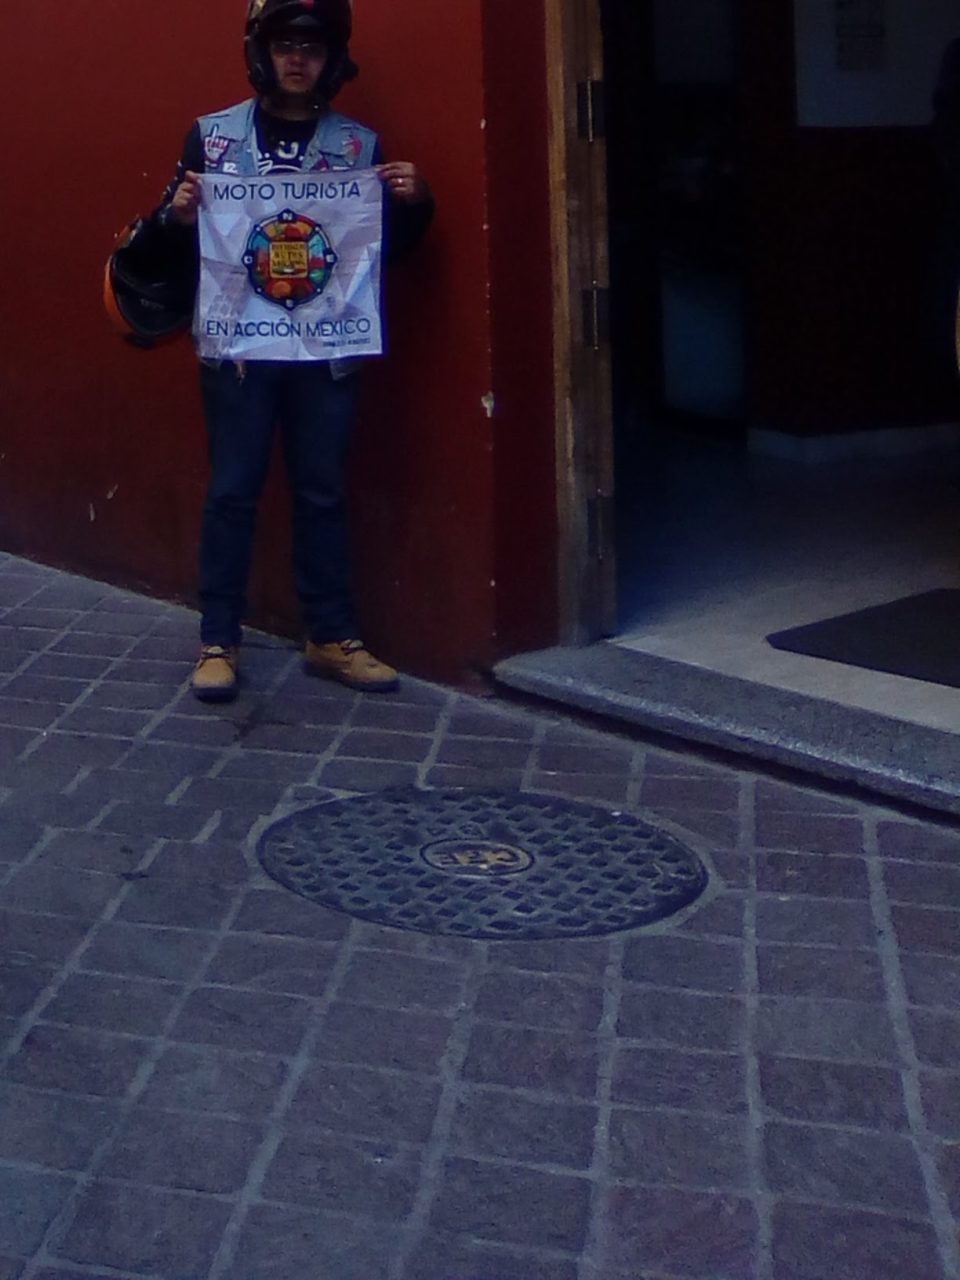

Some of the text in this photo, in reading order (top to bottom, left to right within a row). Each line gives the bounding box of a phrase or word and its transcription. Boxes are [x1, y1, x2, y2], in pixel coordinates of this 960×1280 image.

[213, 181, 361, 200] MOTO TURISTA
[206, 320, 228, 337] EN
[234, 318, 301, 338] ACCIÓN
